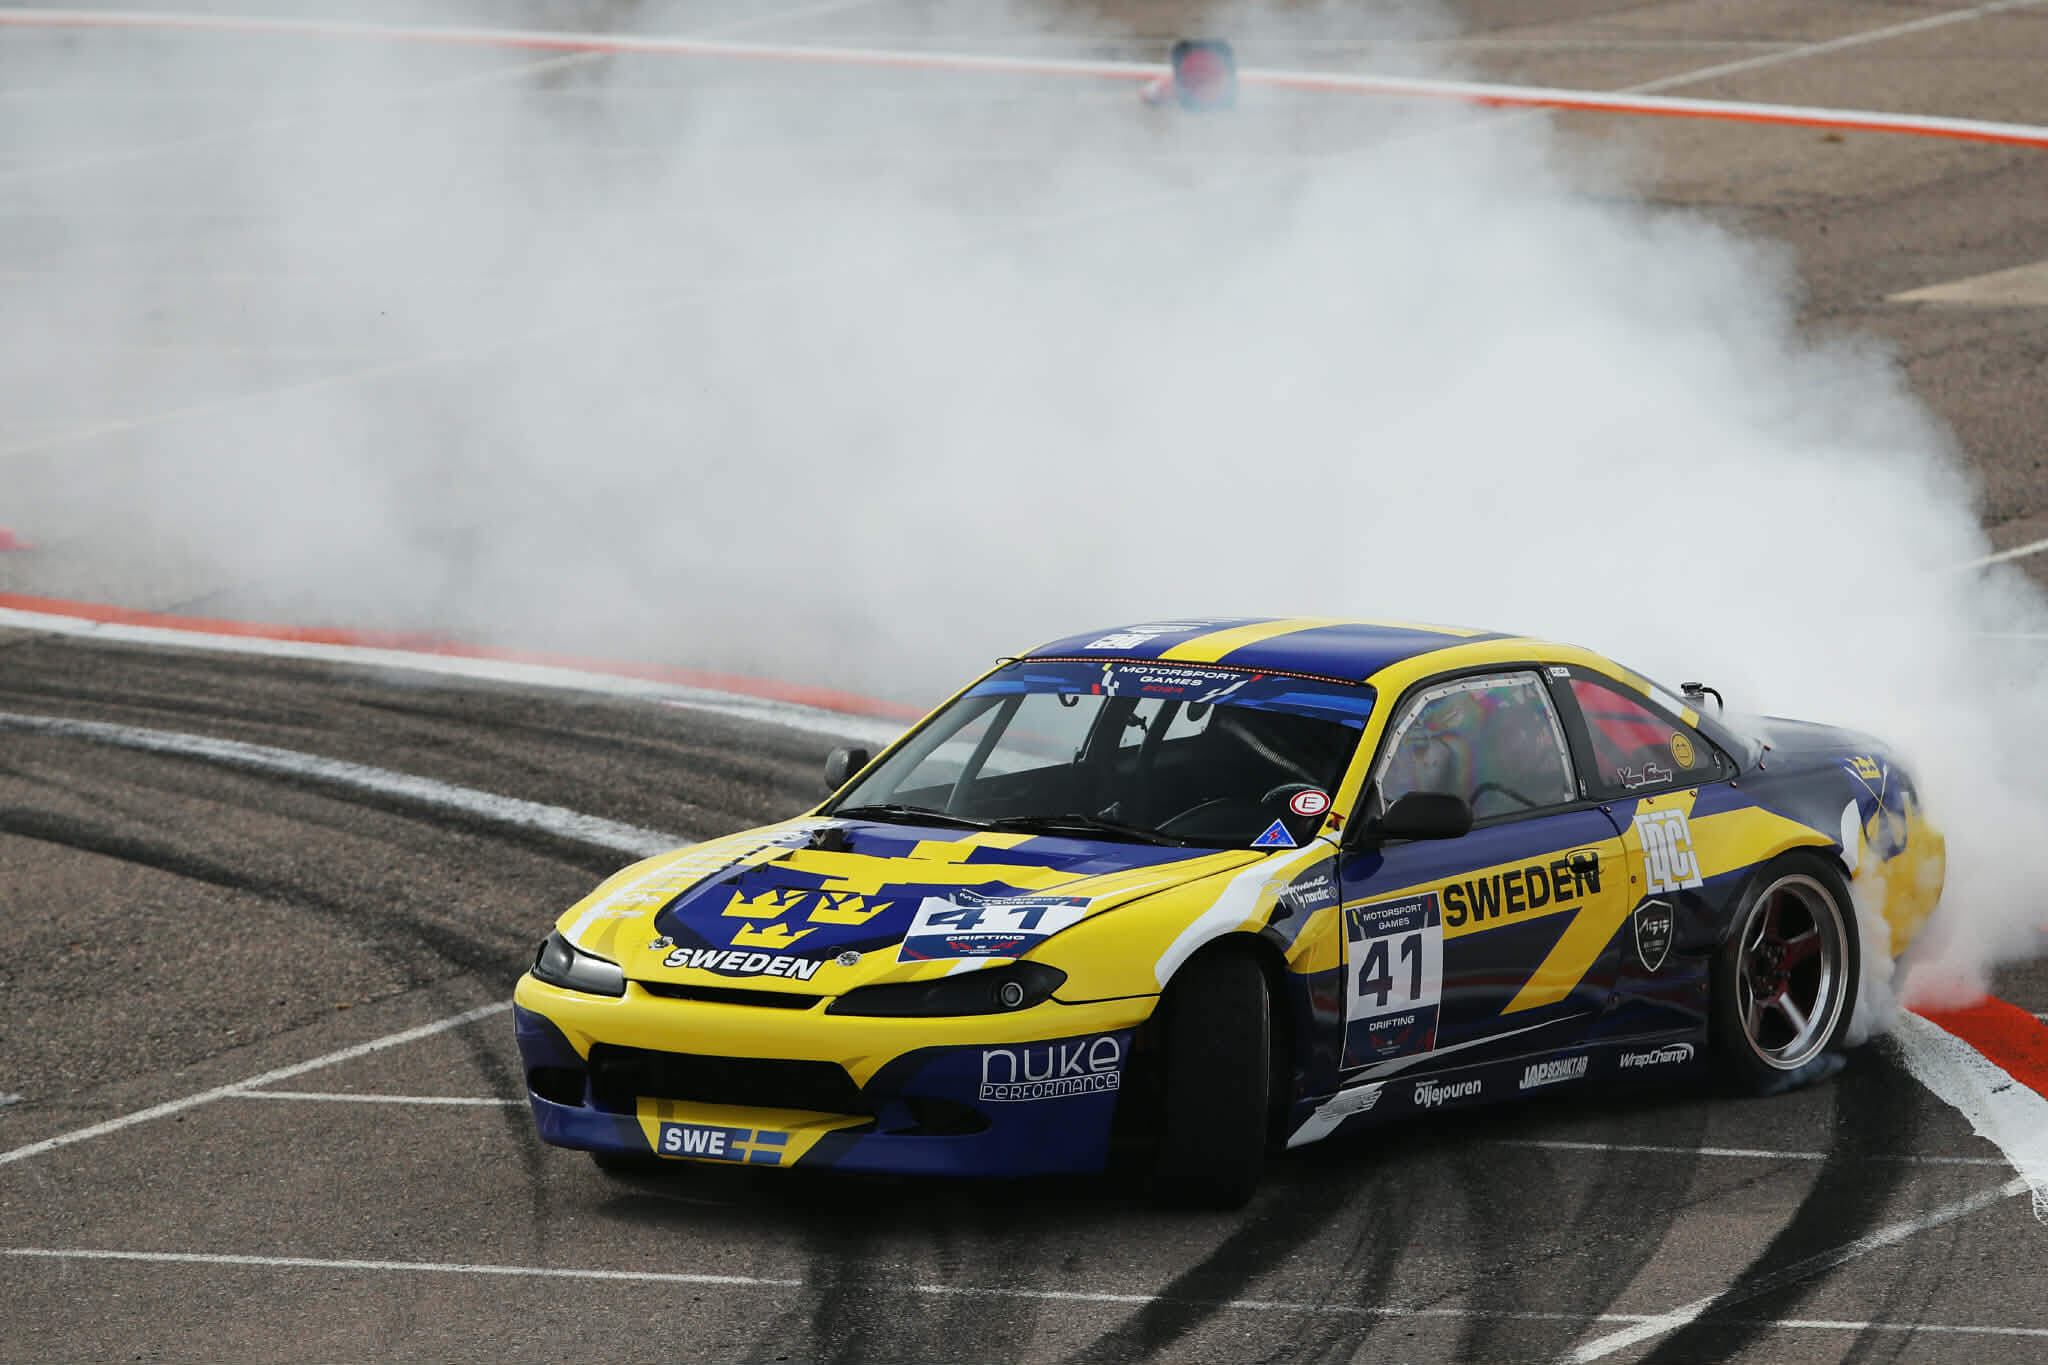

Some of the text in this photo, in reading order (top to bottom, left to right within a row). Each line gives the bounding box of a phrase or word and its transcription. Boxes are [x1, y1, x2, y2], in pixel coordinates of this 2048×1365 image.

[1120, 666, 1240, 681] MOTORSPORT
[1140, 676, 1203, 686] GAMES
[1443, 851, 1601, 927] SWEDEN
[926, 907, 1049, 930] 41
[1363, 904, 1422, 921] MOTORSPORT
[1379, 917, 1410, 930] GAMES
[663, 948, 823, 981] SWEDEN
[1358, 933, 1422, 1007] 41
[1369, 1015, 1416, 1031] DRIFTING
[1619, 1049, 1688, 1069] WrapChamp
[1414, 1080, 1482, 1108] Oljejouren
[664, 1127, 727, 1155] SWE
